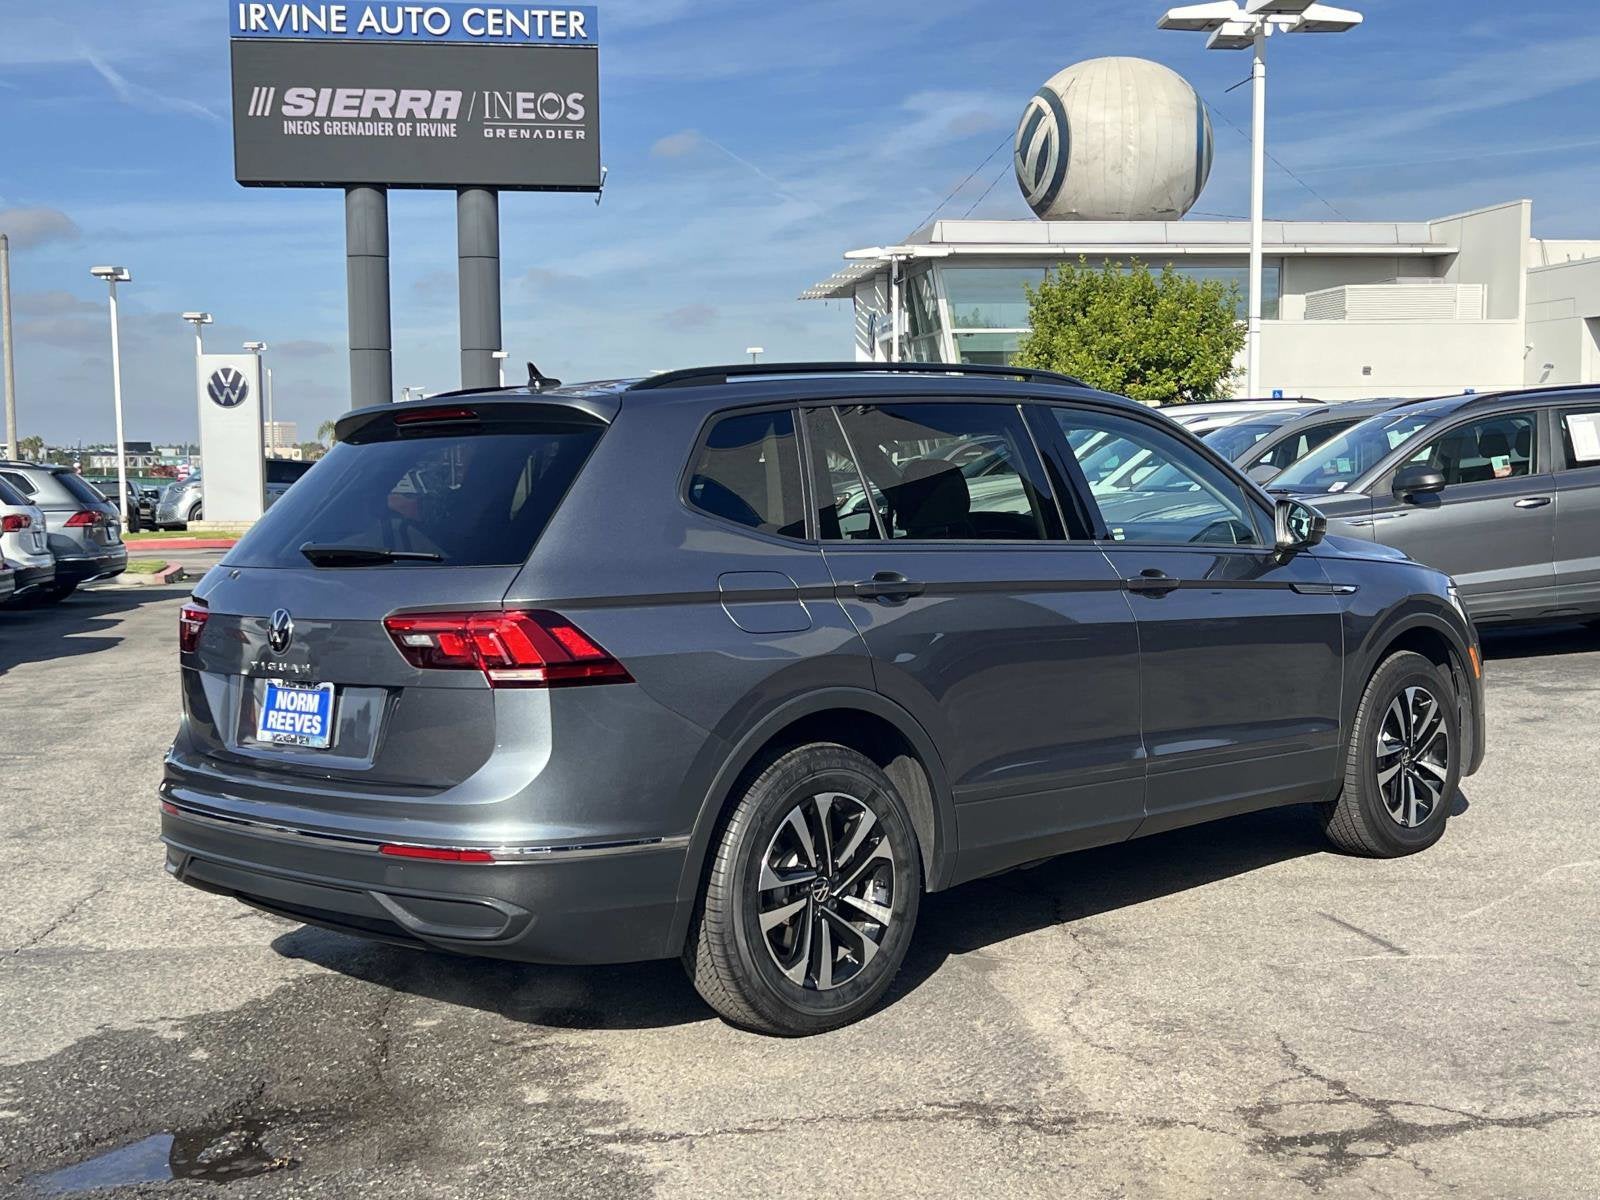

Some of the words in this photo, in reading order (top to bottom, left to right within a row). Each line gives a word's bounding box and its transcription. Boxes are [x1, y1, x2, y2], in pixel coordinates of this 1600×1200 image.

[238, 3, 347, 32] IRVINE
[356, 5, 451, 36] AUTO
[462, 7, 588, 38] CENTER
[281, 87, 463, 120] SIERRA
[483, 91, 586, 121] INEOS
[283, 120, 321, 135] INEOS
[323, 121, 394, 136] GRENADIER
[397, 122, 413, 136] OF
[416, 122, 457, 138] IRVINE
[483, 128, 586, 140] GRENADIER
[275, 690, 320, 713] NORM
[266, 710, 322, 735] REEVES
